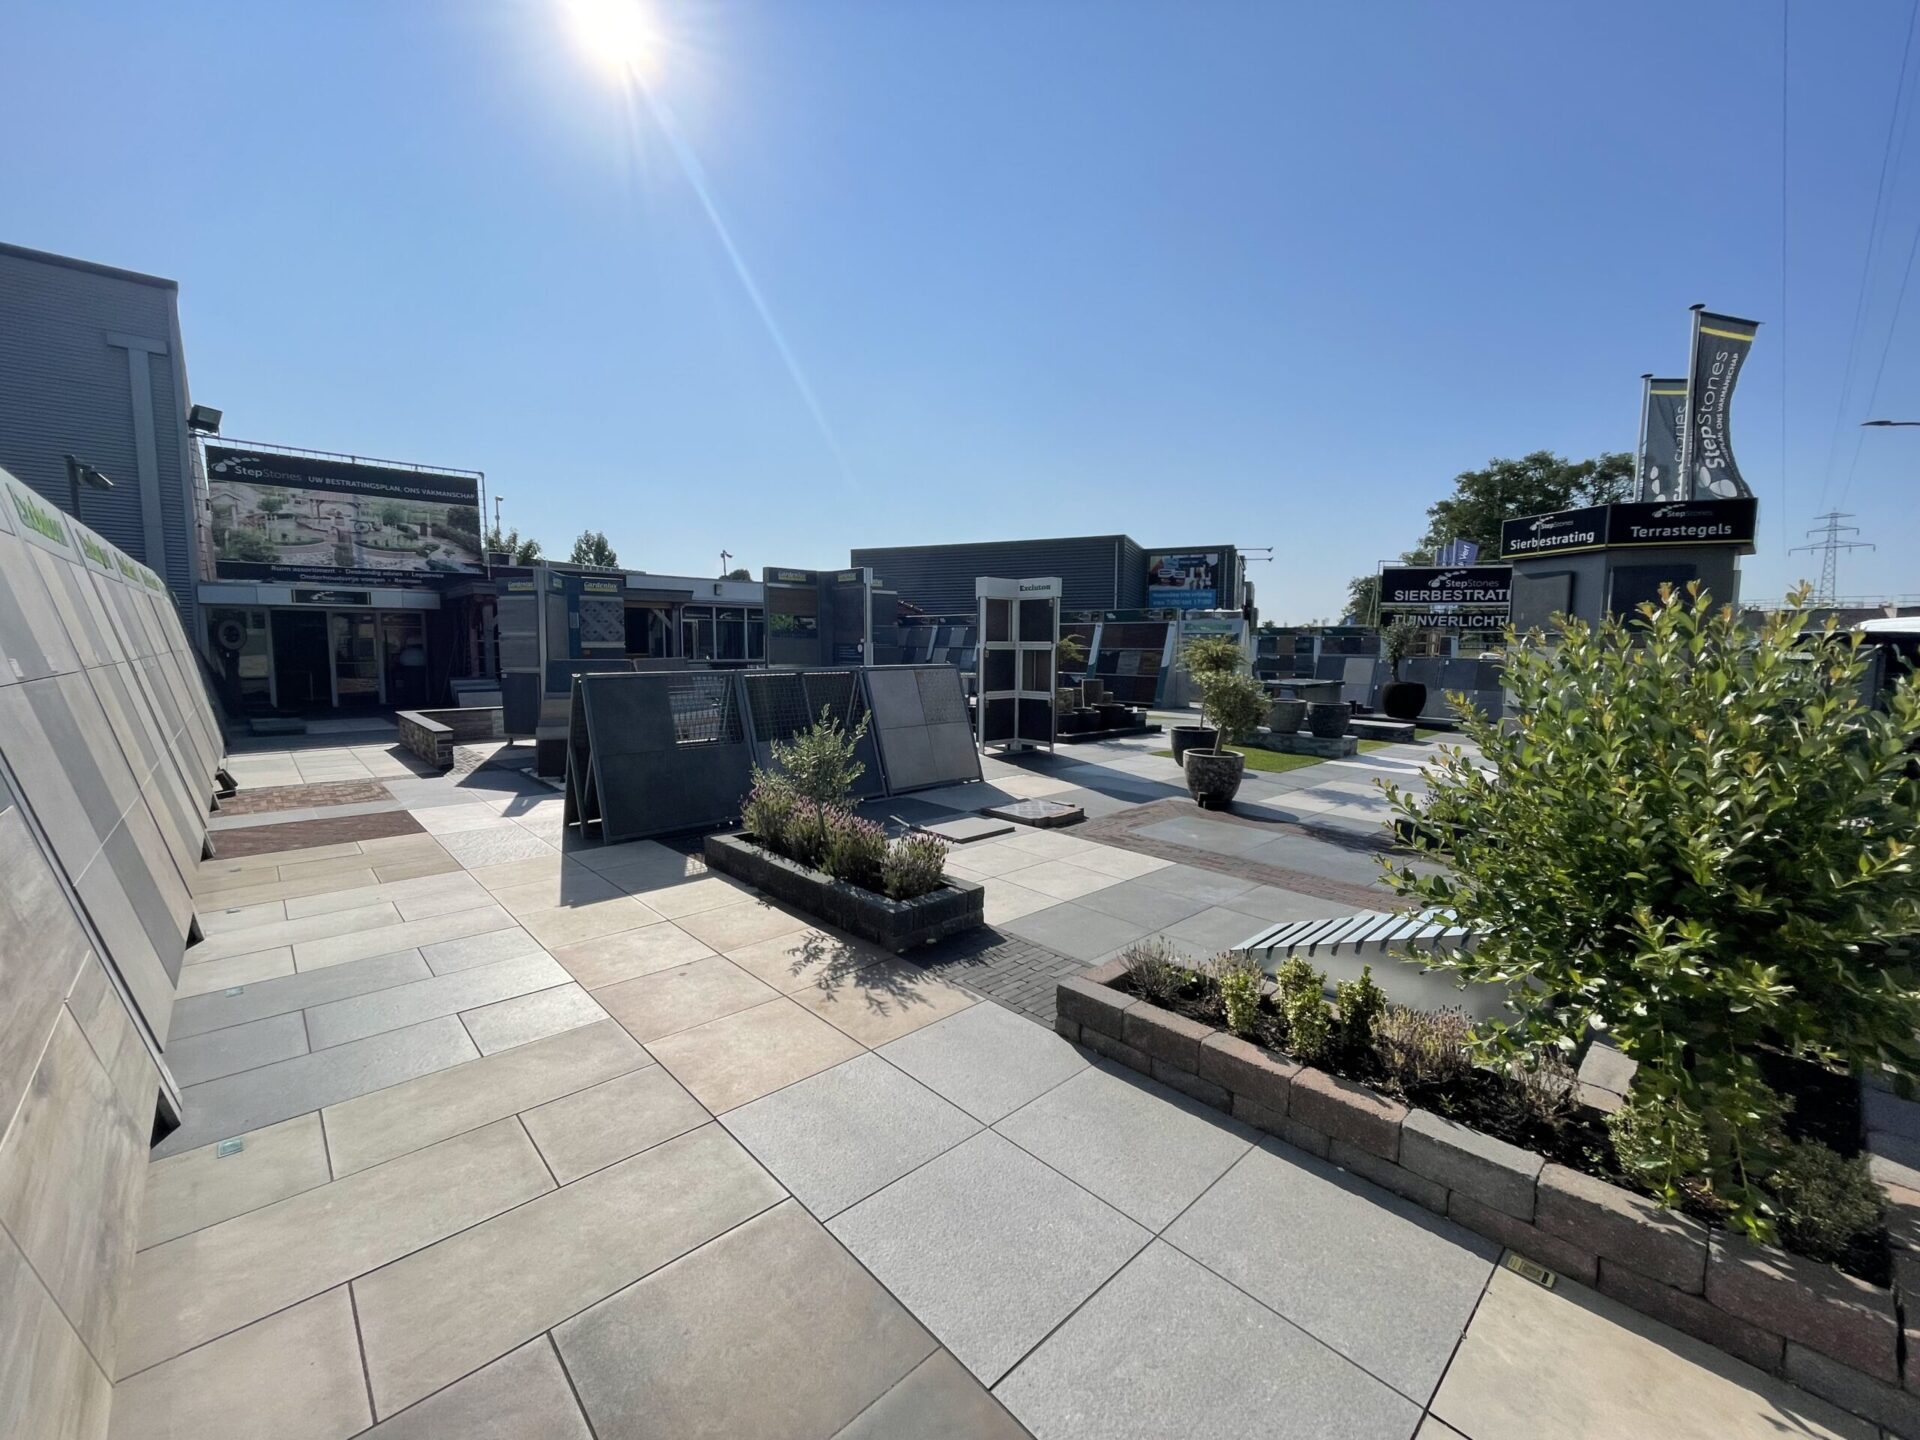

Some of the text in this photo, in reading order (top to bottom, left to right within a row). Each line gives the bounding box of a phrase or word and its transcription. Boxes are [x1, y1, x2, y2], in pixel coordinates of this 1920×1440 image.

[1717, 352, 1739, 412] VAKMANSCHAP
[1697, 350, 1729, 469] StepStones
[1716, 413, 1724, 429] ONS
[234, 465, 302, 481] StepStones
[308, 475, 323, 484] UW
[403, 486, 420, 495] ONS
[421, 488, 475, 499] VAKMANSCHAP
[1630, 523, 1732, 538] Terrastegels
[1510, 531, 1595, 550] Sierbestrating
[1445, 580, 1499, 589] StepStones
